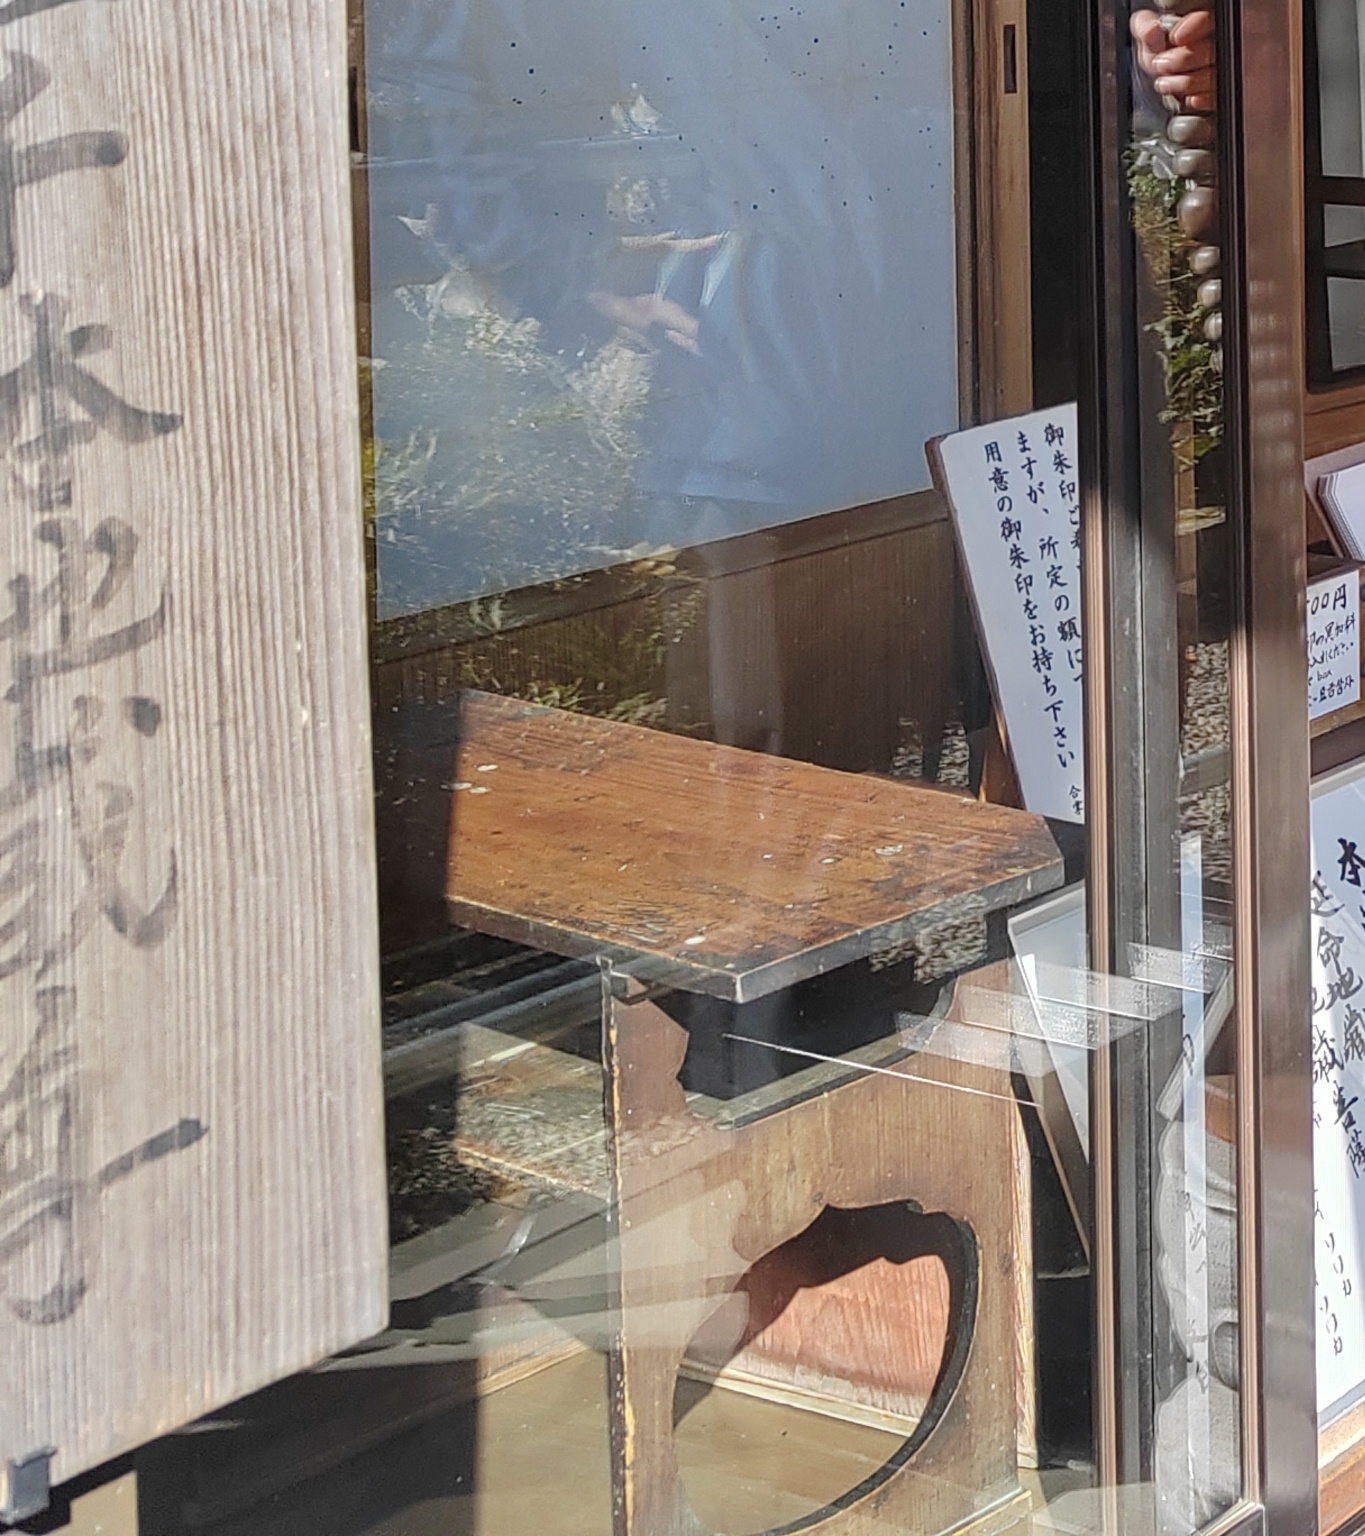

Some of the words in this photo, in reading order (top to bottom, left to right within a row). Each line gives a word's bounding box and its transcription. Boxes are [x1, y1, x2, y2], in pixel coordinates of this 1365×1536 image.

[1044, 423, 1082, 572] 御朱印ご
[983, 442, 1075, 768] 用意の御朱印をお持ち下さい
[1306, 583, 1347, 615] 00円
